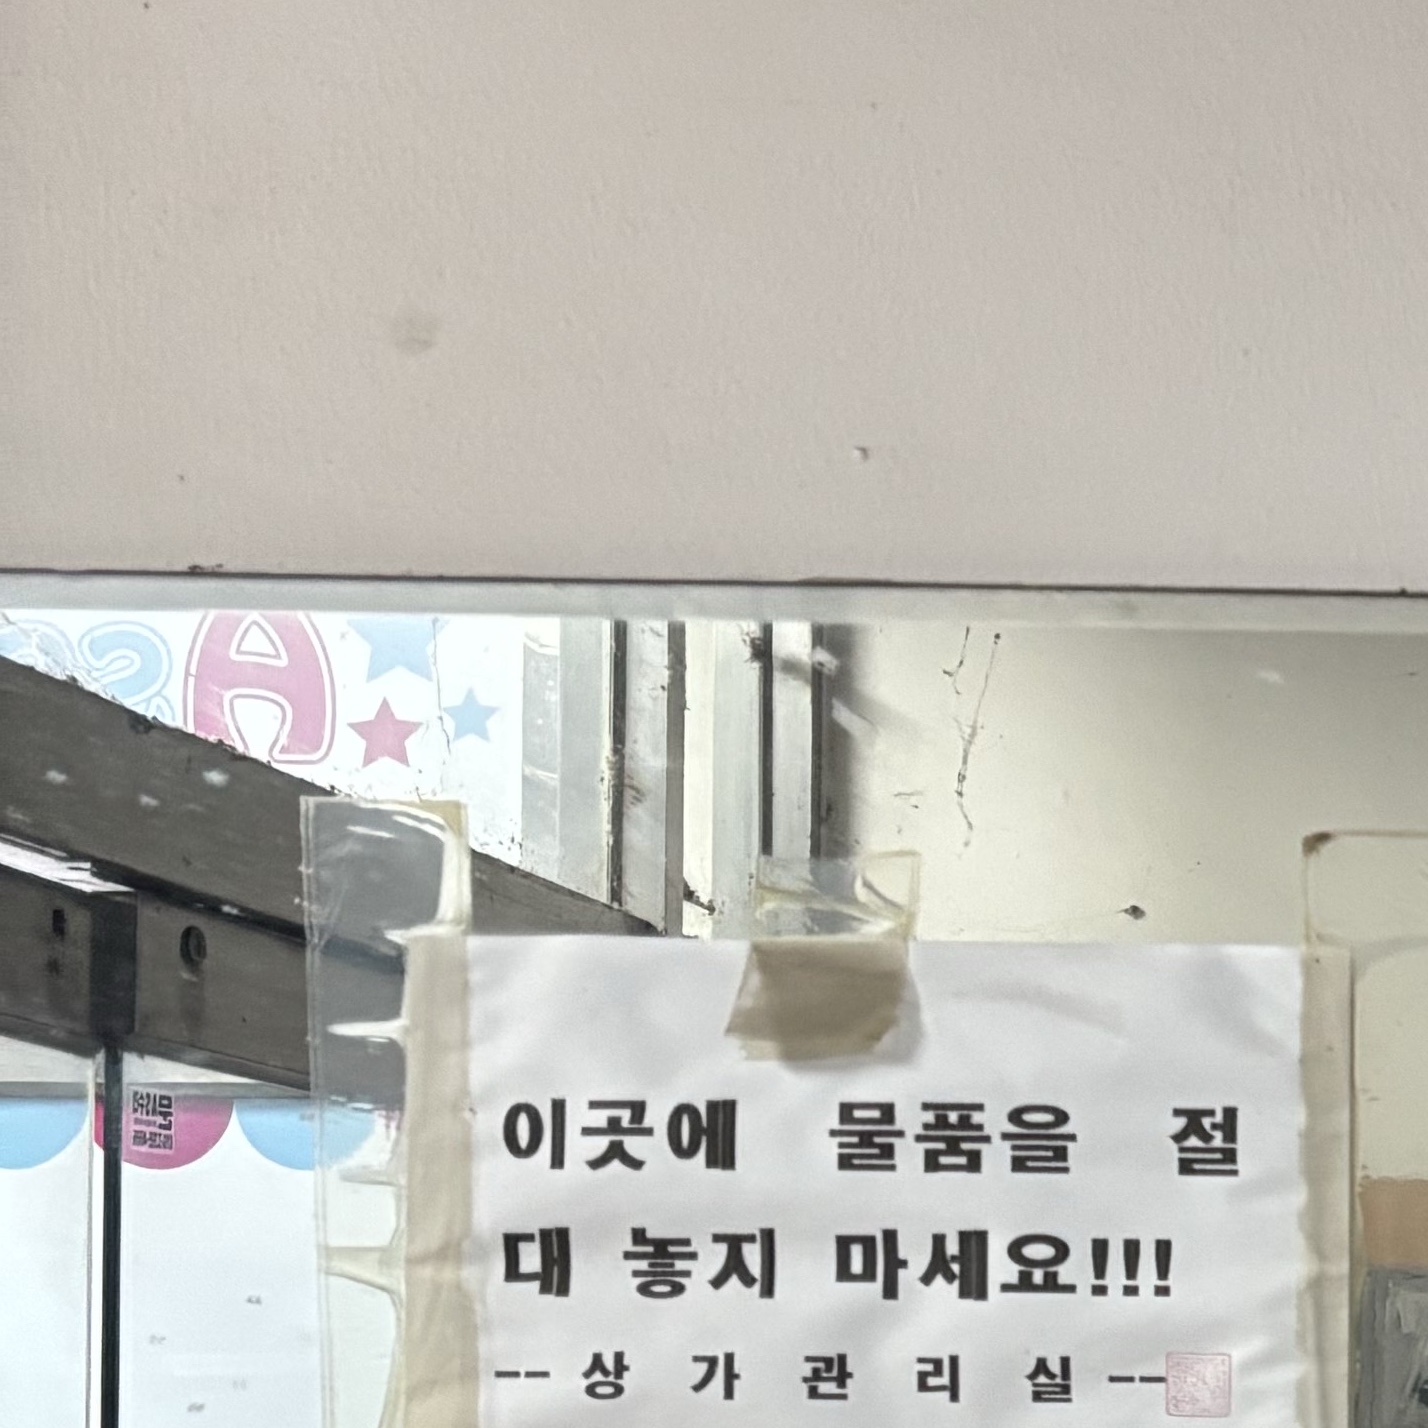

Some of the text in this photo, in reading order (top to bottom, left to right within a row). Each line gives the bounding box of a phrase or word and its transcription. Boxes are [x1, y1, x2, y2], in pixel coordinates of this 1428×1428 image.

[502, 1098, 1241, 1176] 이곳에 물품을 절
[502, 1228, 1174, 1302] 대 놓지 마세요!!!
[582, 1352, 629, 1399] 상
[691, 1356, 739, 1400] 가
[802, 1356, 853, 1400] 관
[917, 1355, 960, 1402] 리
[1025, 1356, 1075, 1404] 실
